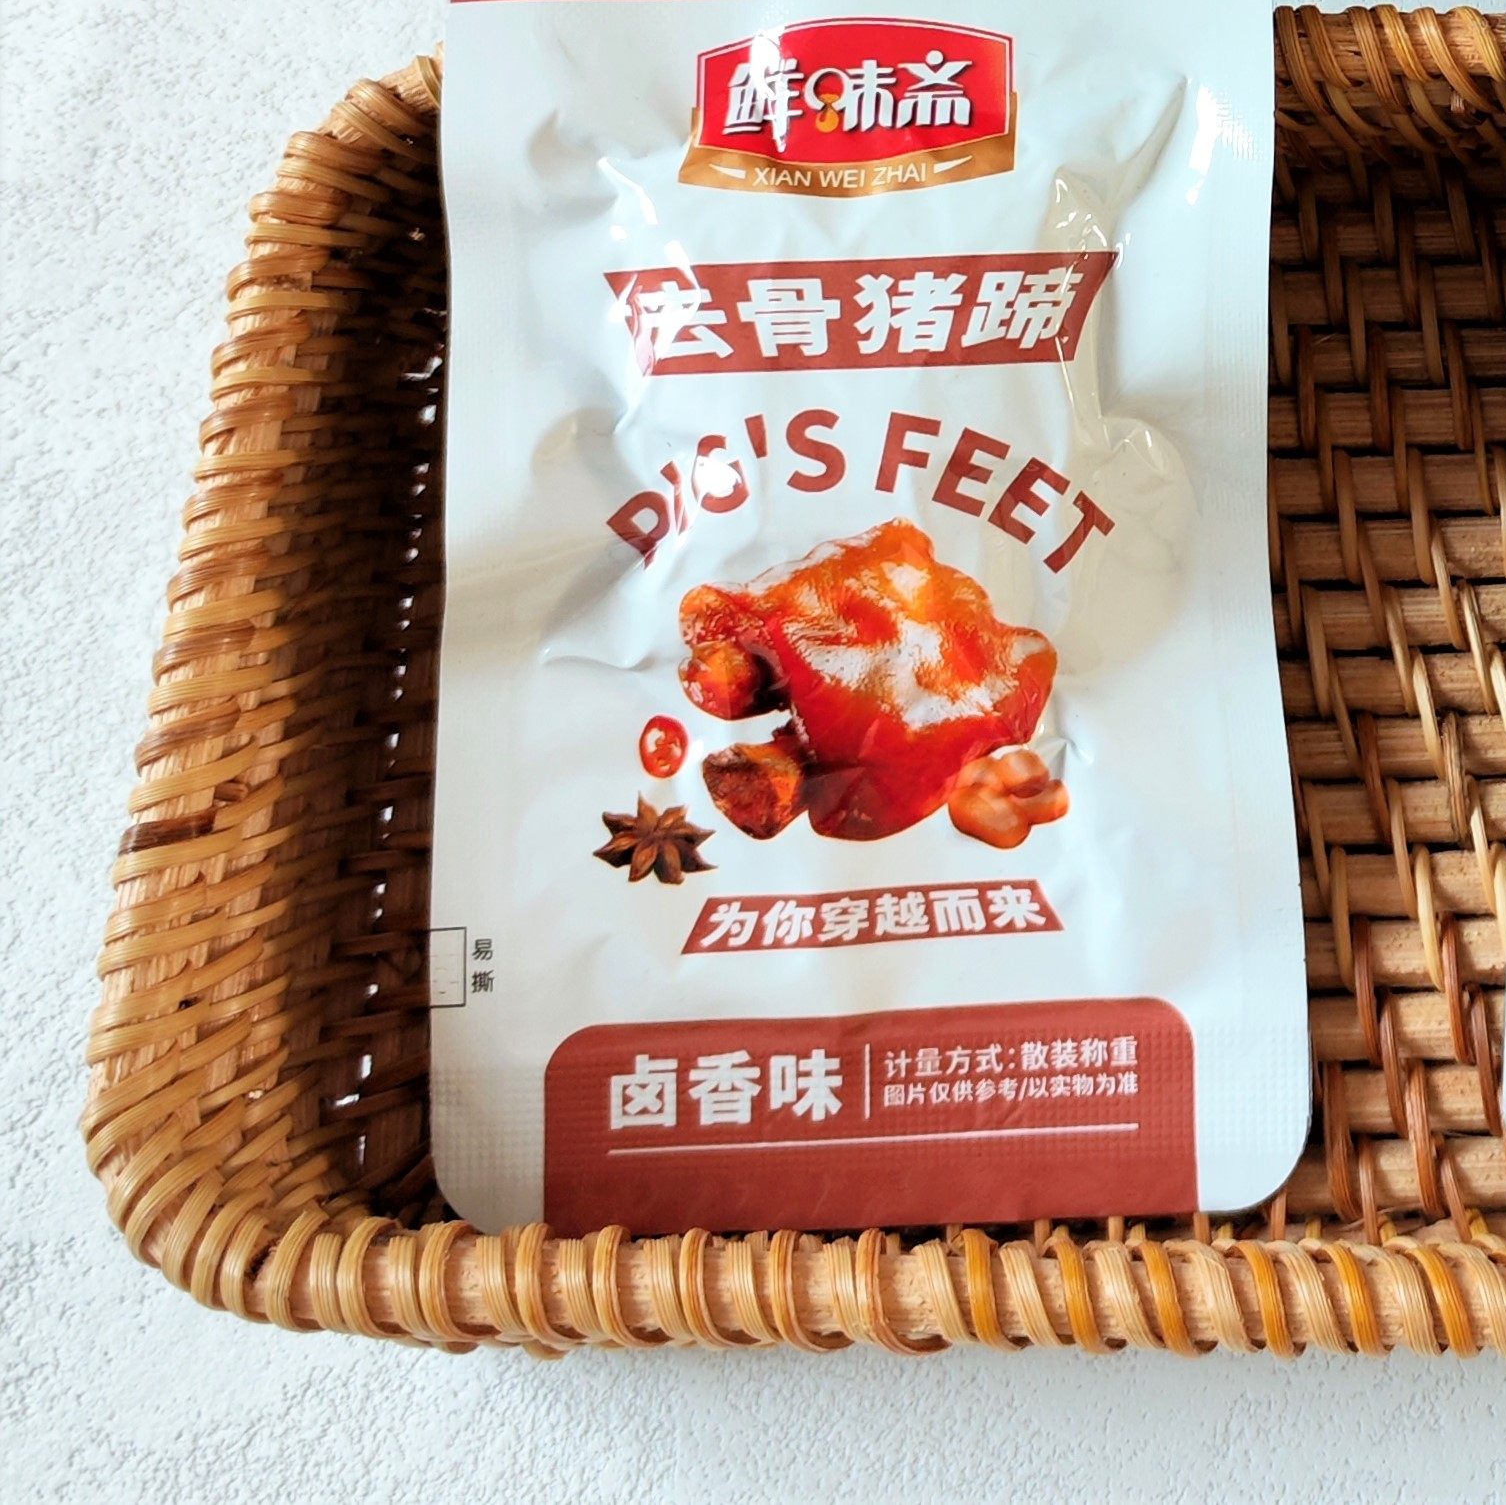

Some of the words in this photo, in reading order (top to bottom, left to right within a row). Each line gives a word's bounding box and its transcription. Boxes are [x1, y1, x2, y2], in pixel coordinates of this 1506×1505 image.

[752, 167, 812, 189] XIAN
[818, 165, 868, 188] WEI
[872, 162, 928, 186] ZHAI
[632, 269, 1078, 361] 去骨猪蹄
[606, 409, 848, 569] PIG'S
[874, 412, 1116, 575] FEET
[701, 885, 1048, 948] 为你穿越而来
[471, 938, 495, 996] 易撕
[608, 1046, 843, 1130] 卤香味
